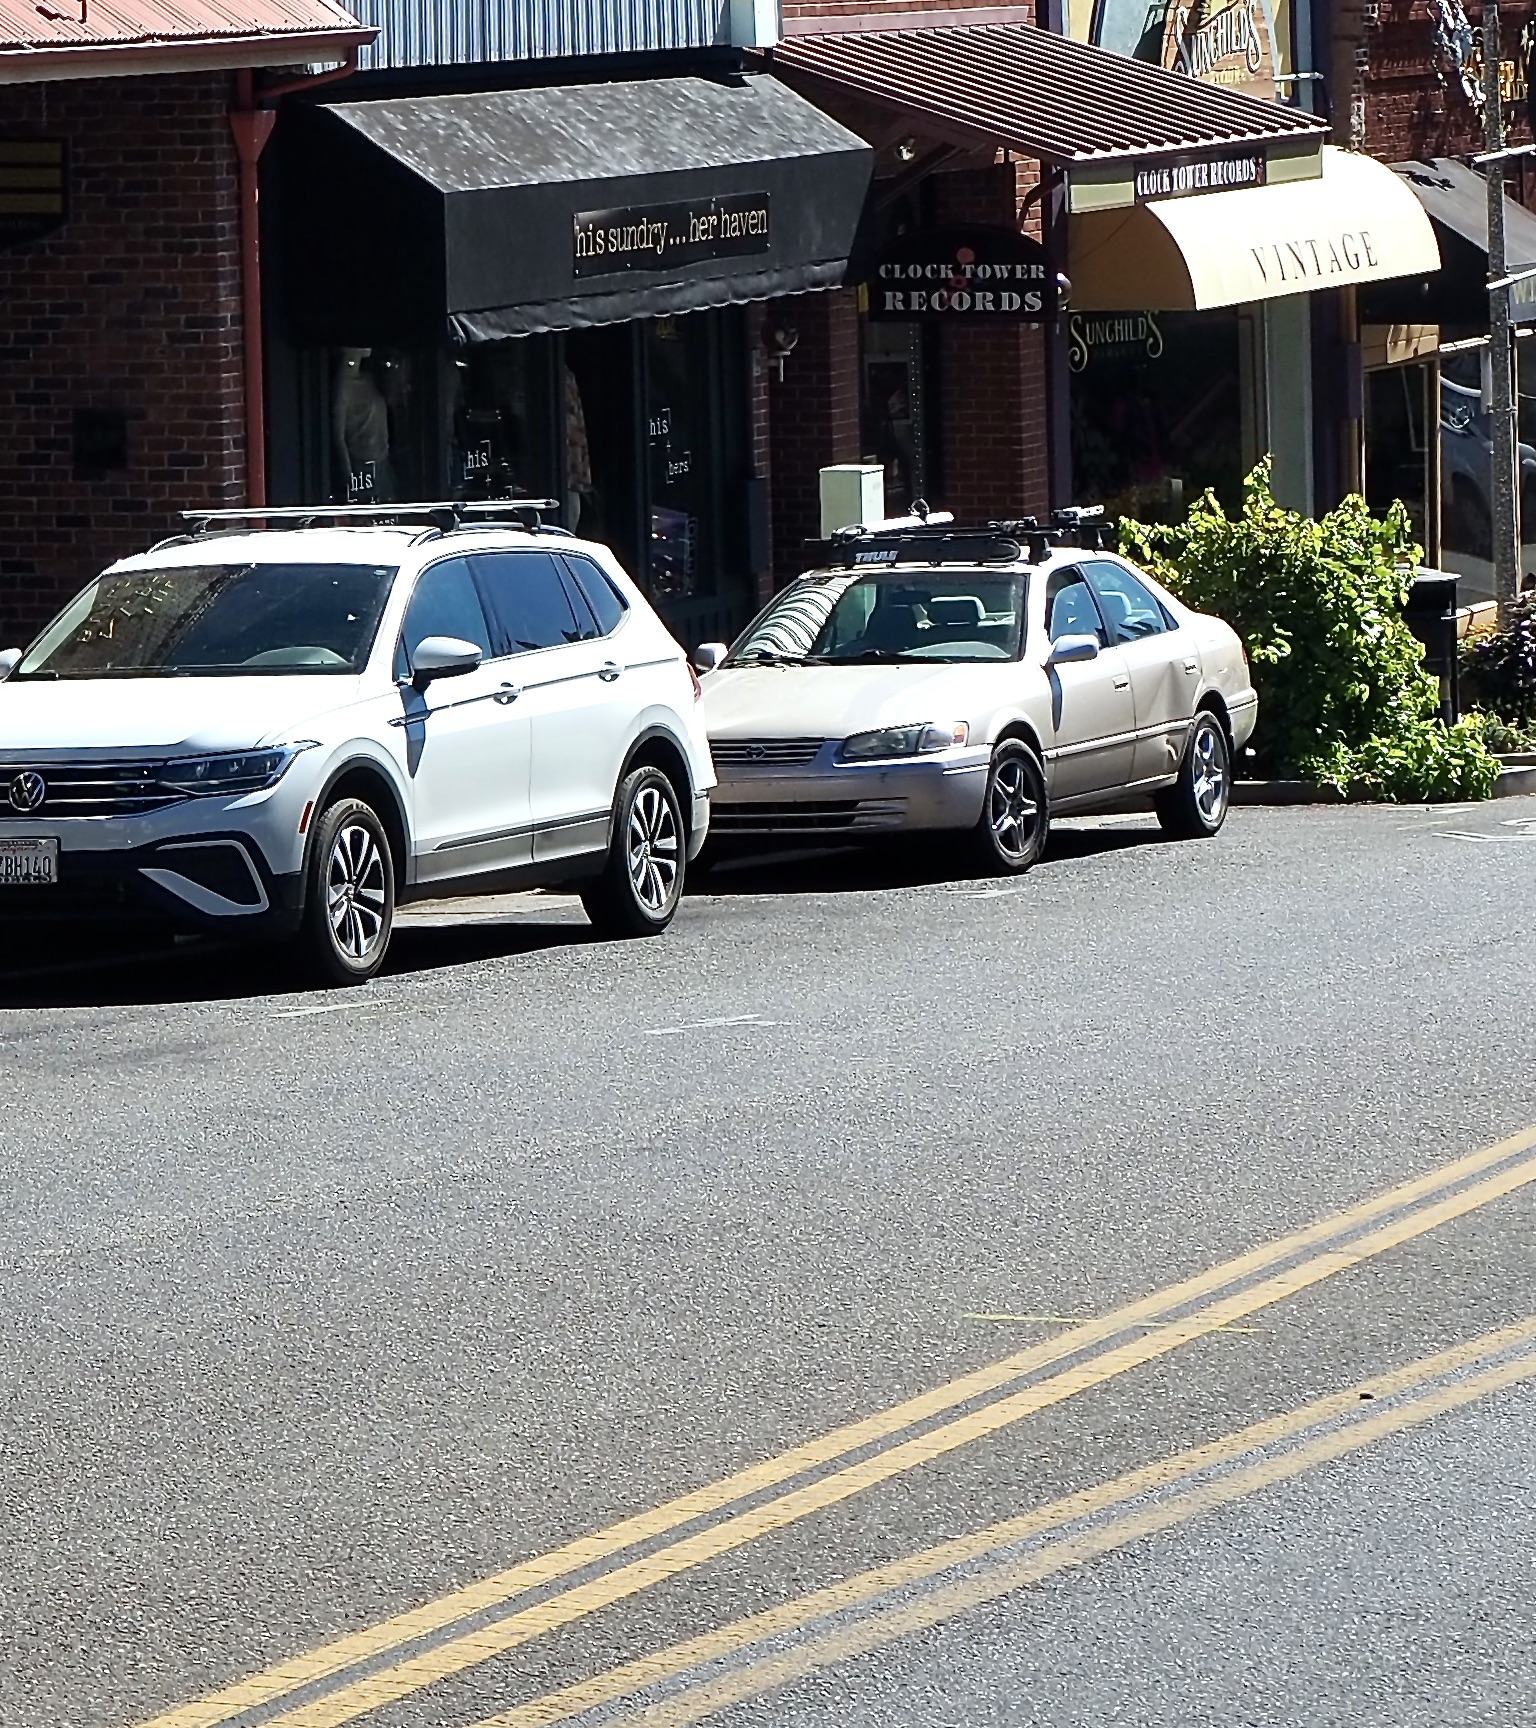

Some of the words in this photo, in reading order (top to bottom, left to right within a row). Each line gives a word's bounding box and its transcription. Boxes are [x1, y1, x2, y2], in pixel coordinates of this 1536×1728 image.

[1137, 169, 1172, 197] CLOCK
[1172, 163, 1209, 191] TOWER
[1210, 156, 1257, 187] RECORDS
[574, 222, 605, 258] his
[719, 207, 768, 239] haven
[1250, 230, 1379, 283] VINTAGE
[879, 264, 955, 279] CLOCK
[961, 264, 1046, 279] TOWER
[883, 290, 1043, 312] RECORDS
[648, 418, 670, 437] his
[466, 449, 489, 470] his
[349, 470, 374, 493] his
[855, 550, 898, 563] THULE
